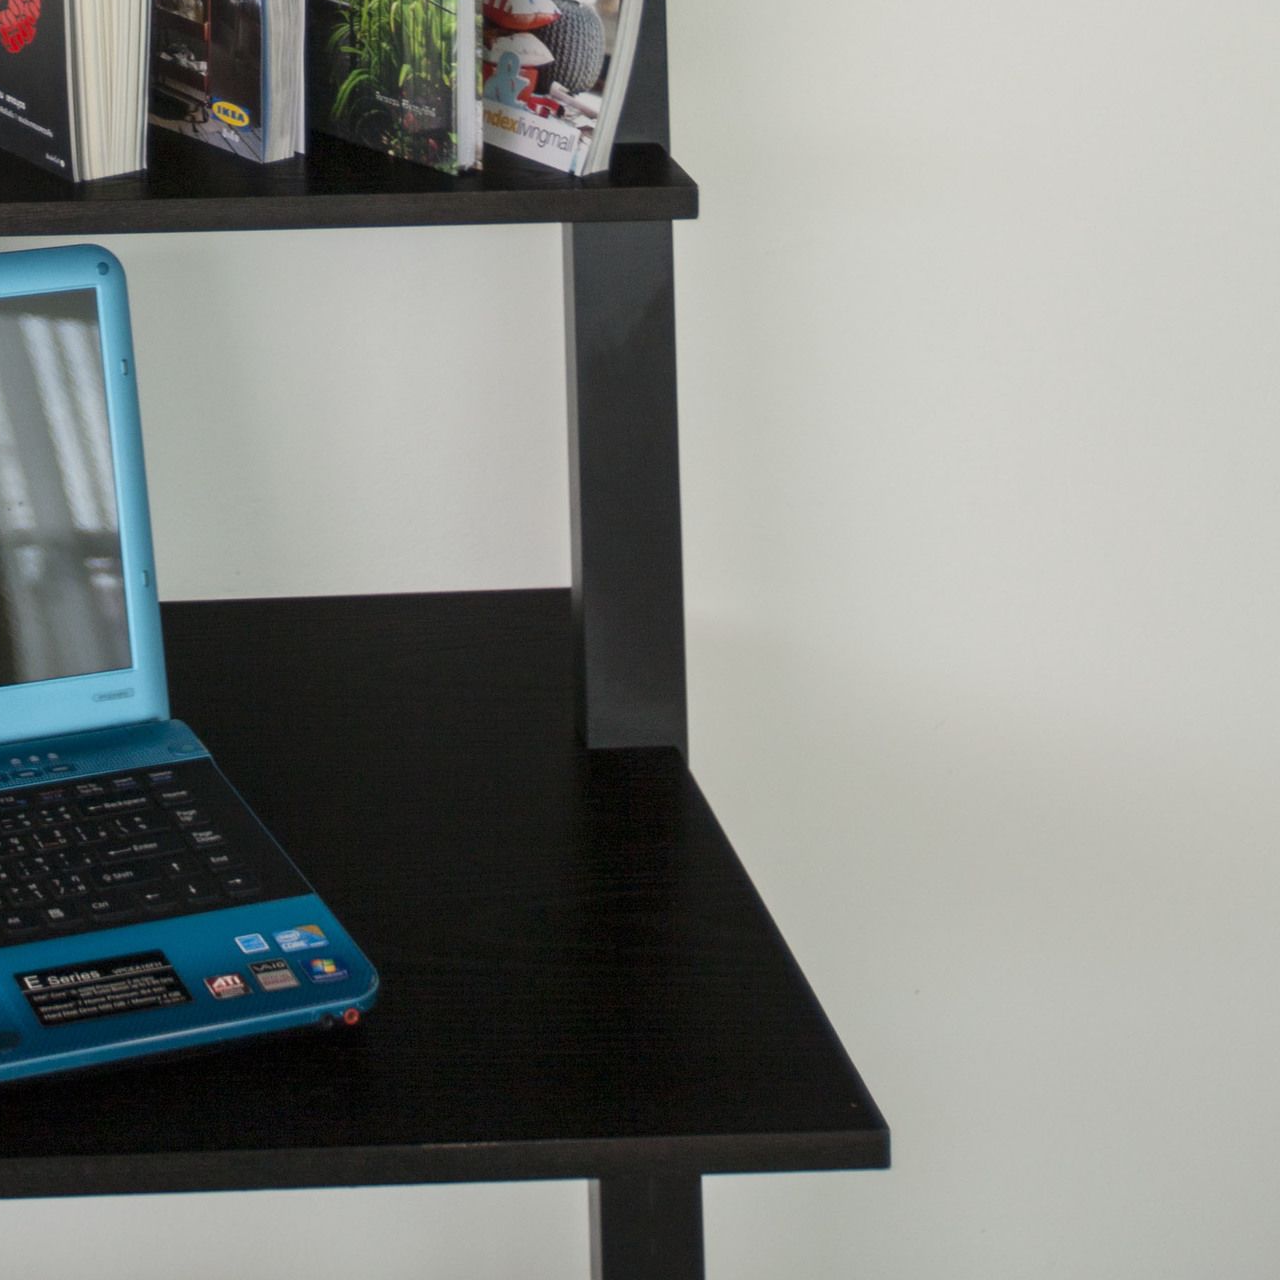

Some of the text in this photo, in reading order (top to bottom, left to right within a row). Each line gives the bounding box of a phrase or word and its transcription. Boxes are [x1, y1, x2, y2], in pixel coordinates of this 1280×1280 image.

[23, 975, 42, 989] E
[47, 970, 101, 986] Series
[213, 975, 240, 989] ATI
